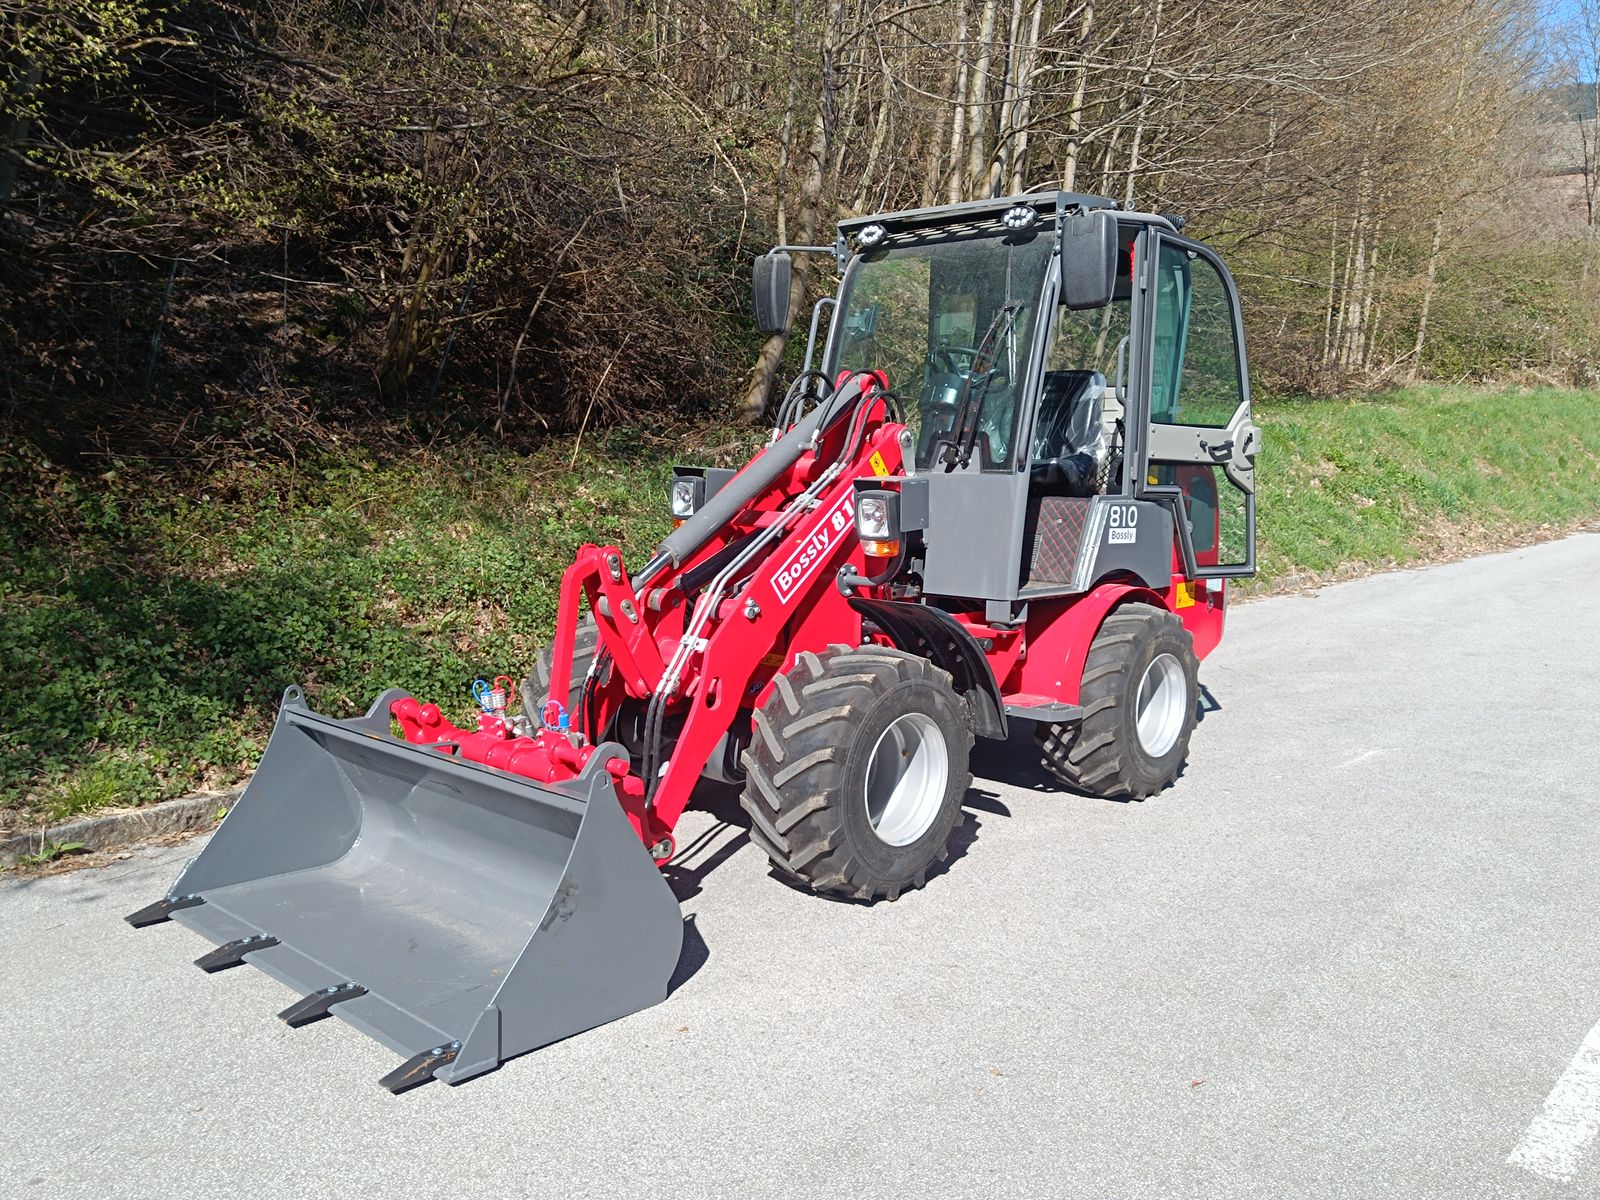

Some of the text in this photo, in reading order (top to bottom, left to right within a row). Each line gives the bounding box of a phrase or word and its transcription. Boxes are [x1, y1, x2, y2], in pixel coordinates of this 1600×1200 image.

[1110, 505, 1138, 527] 810
[777, 493, 855, 592] Bossly 81
[1111, 530, 1134, 541] Bossly
